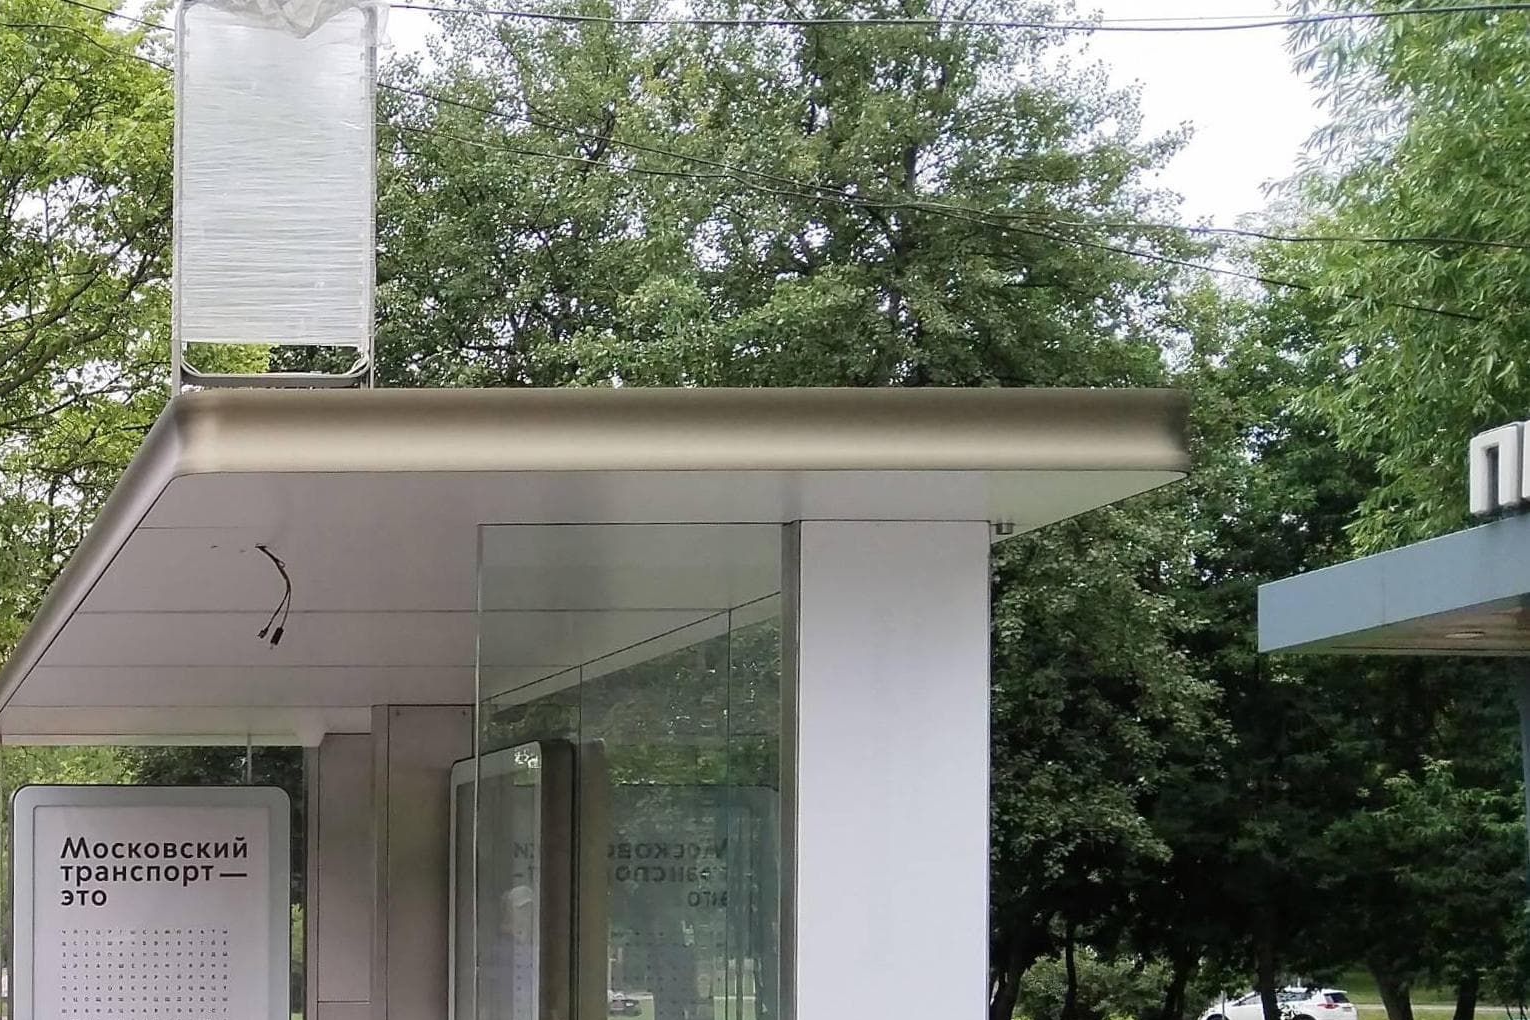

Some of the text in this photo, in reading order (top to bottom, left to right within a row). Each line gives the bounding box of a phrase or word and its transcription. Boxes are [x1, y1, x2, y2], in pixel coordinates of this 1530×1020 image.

[60, 837, 248, 859] Московский
[60, 865, 214, 887] транспорт
[60, 890, 108, 906] это
